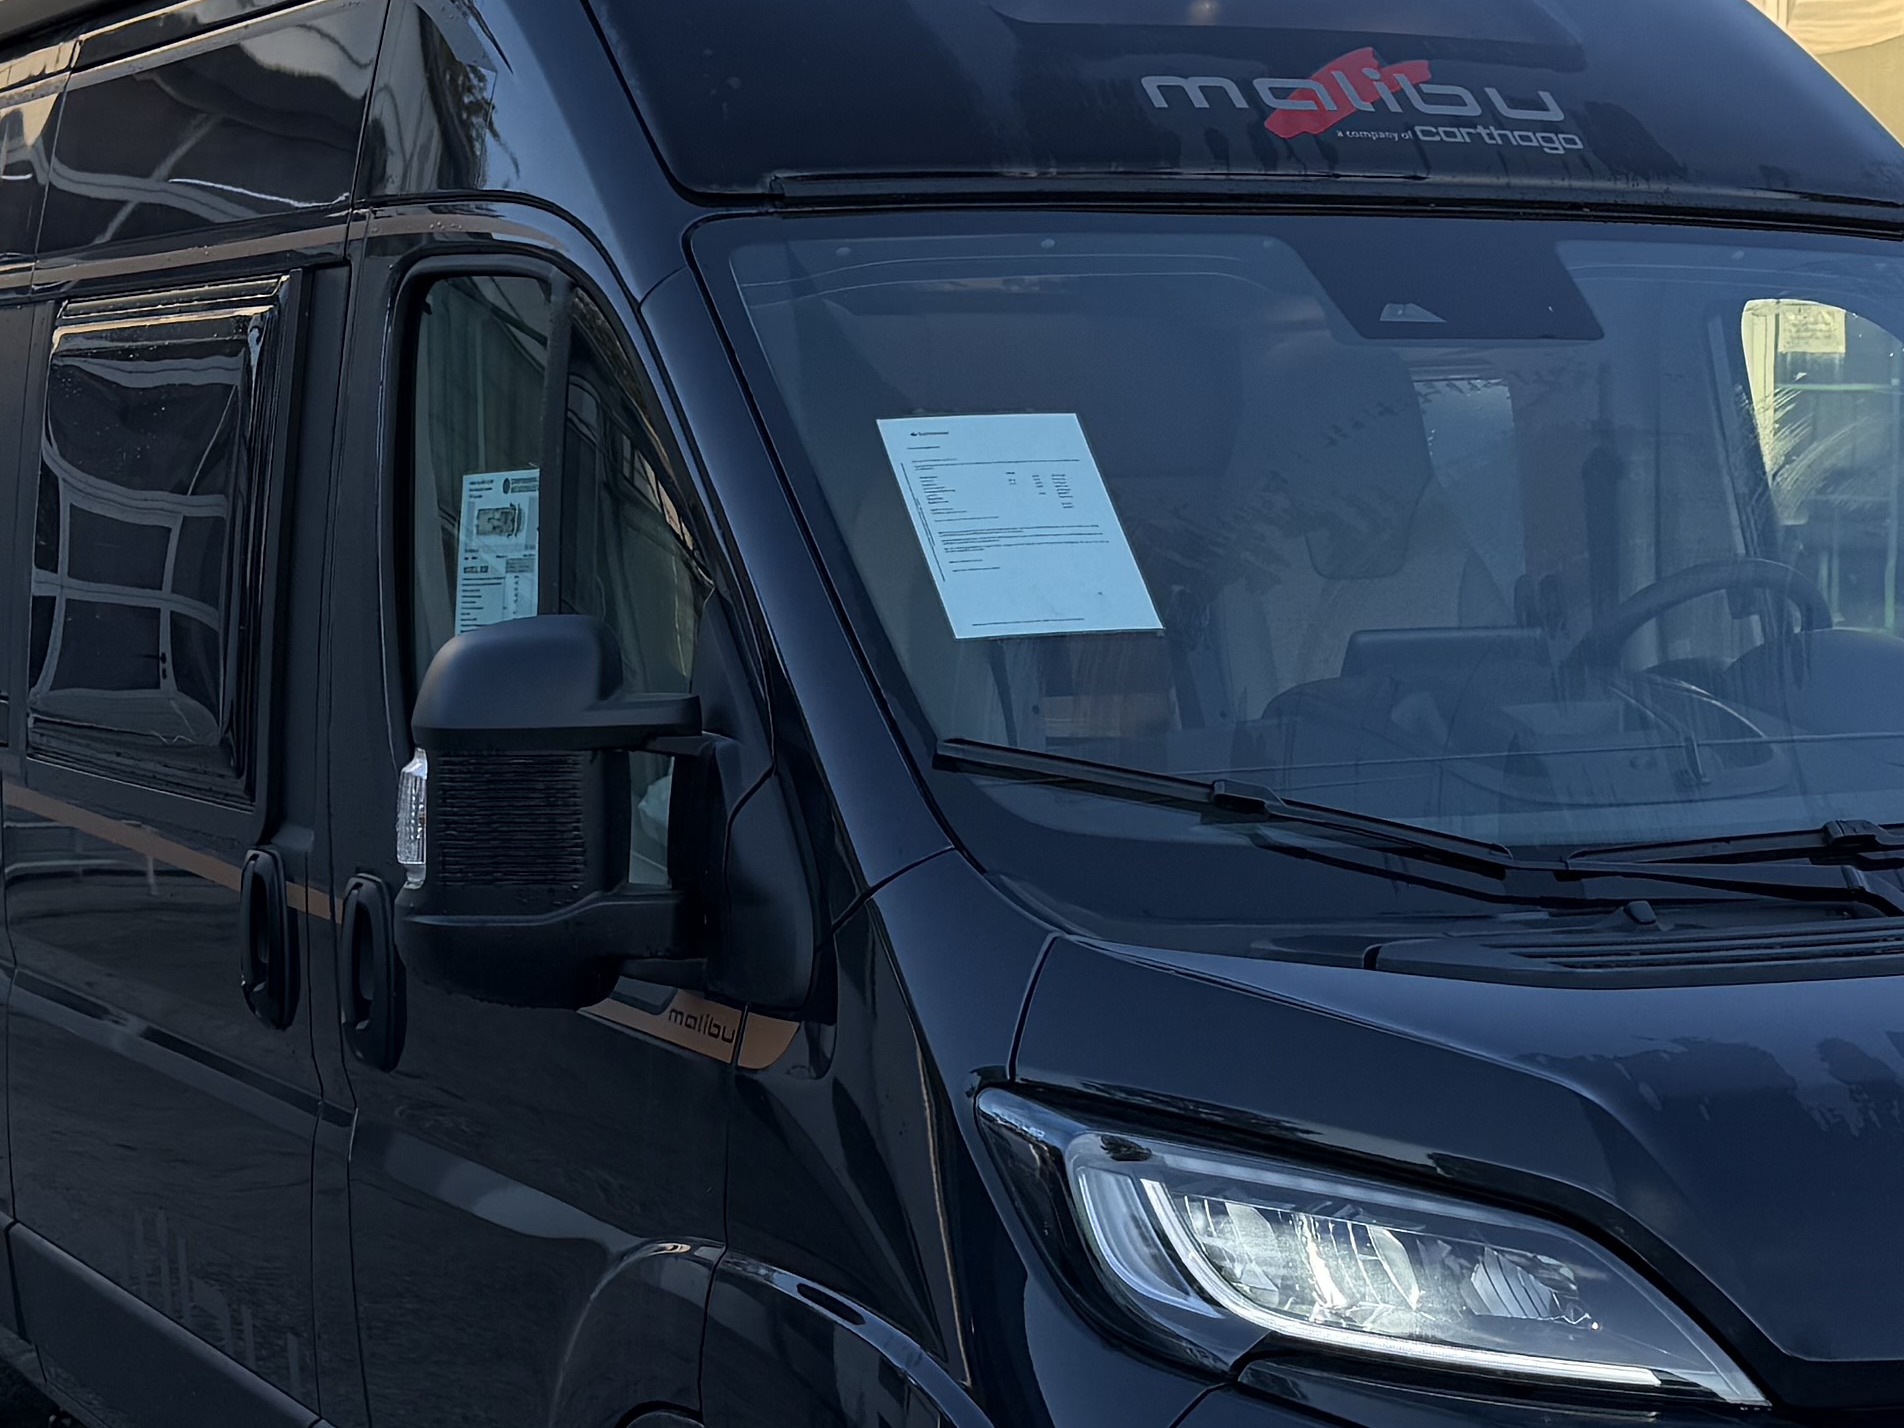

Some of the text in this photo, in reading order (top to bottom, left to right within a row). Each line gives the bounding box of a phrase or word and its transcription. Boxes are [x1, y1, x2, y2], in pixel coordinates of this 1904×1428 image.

[1141, 67, 1566, 122] malibu
[1345, 129, 1399, 142] company
[1413, 124, 1584, 155] carthago
